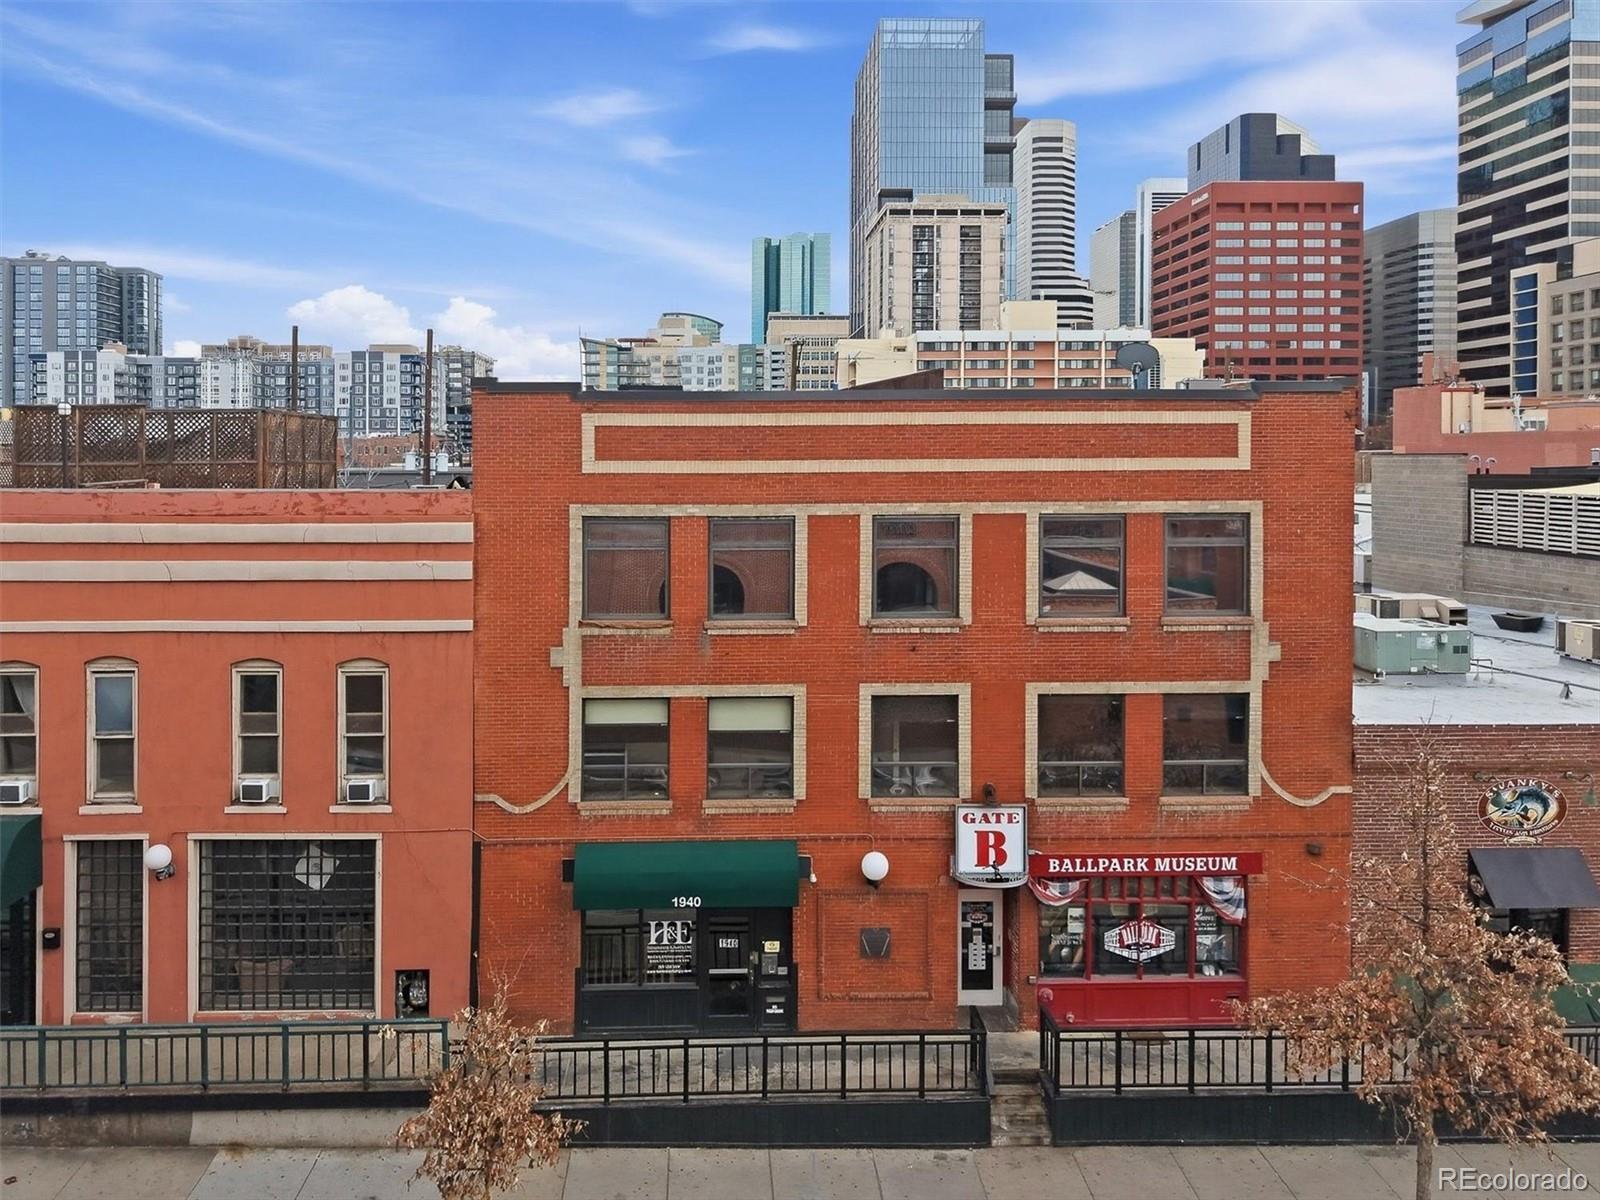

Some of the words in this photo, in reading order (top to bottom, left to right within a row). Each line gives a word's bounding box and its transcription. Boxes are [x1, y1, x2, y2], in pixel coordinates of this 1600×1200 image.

[962, 812, 1020, 824] GATE
[974, 830, 1007, 869] B
[1048, 857, 1149, 873] BALLPARK
[1155, 856, 1238, 872] MUSEUM
[671, 896, 701, 908] 1940
[647, 920, 693, 945] H&E
